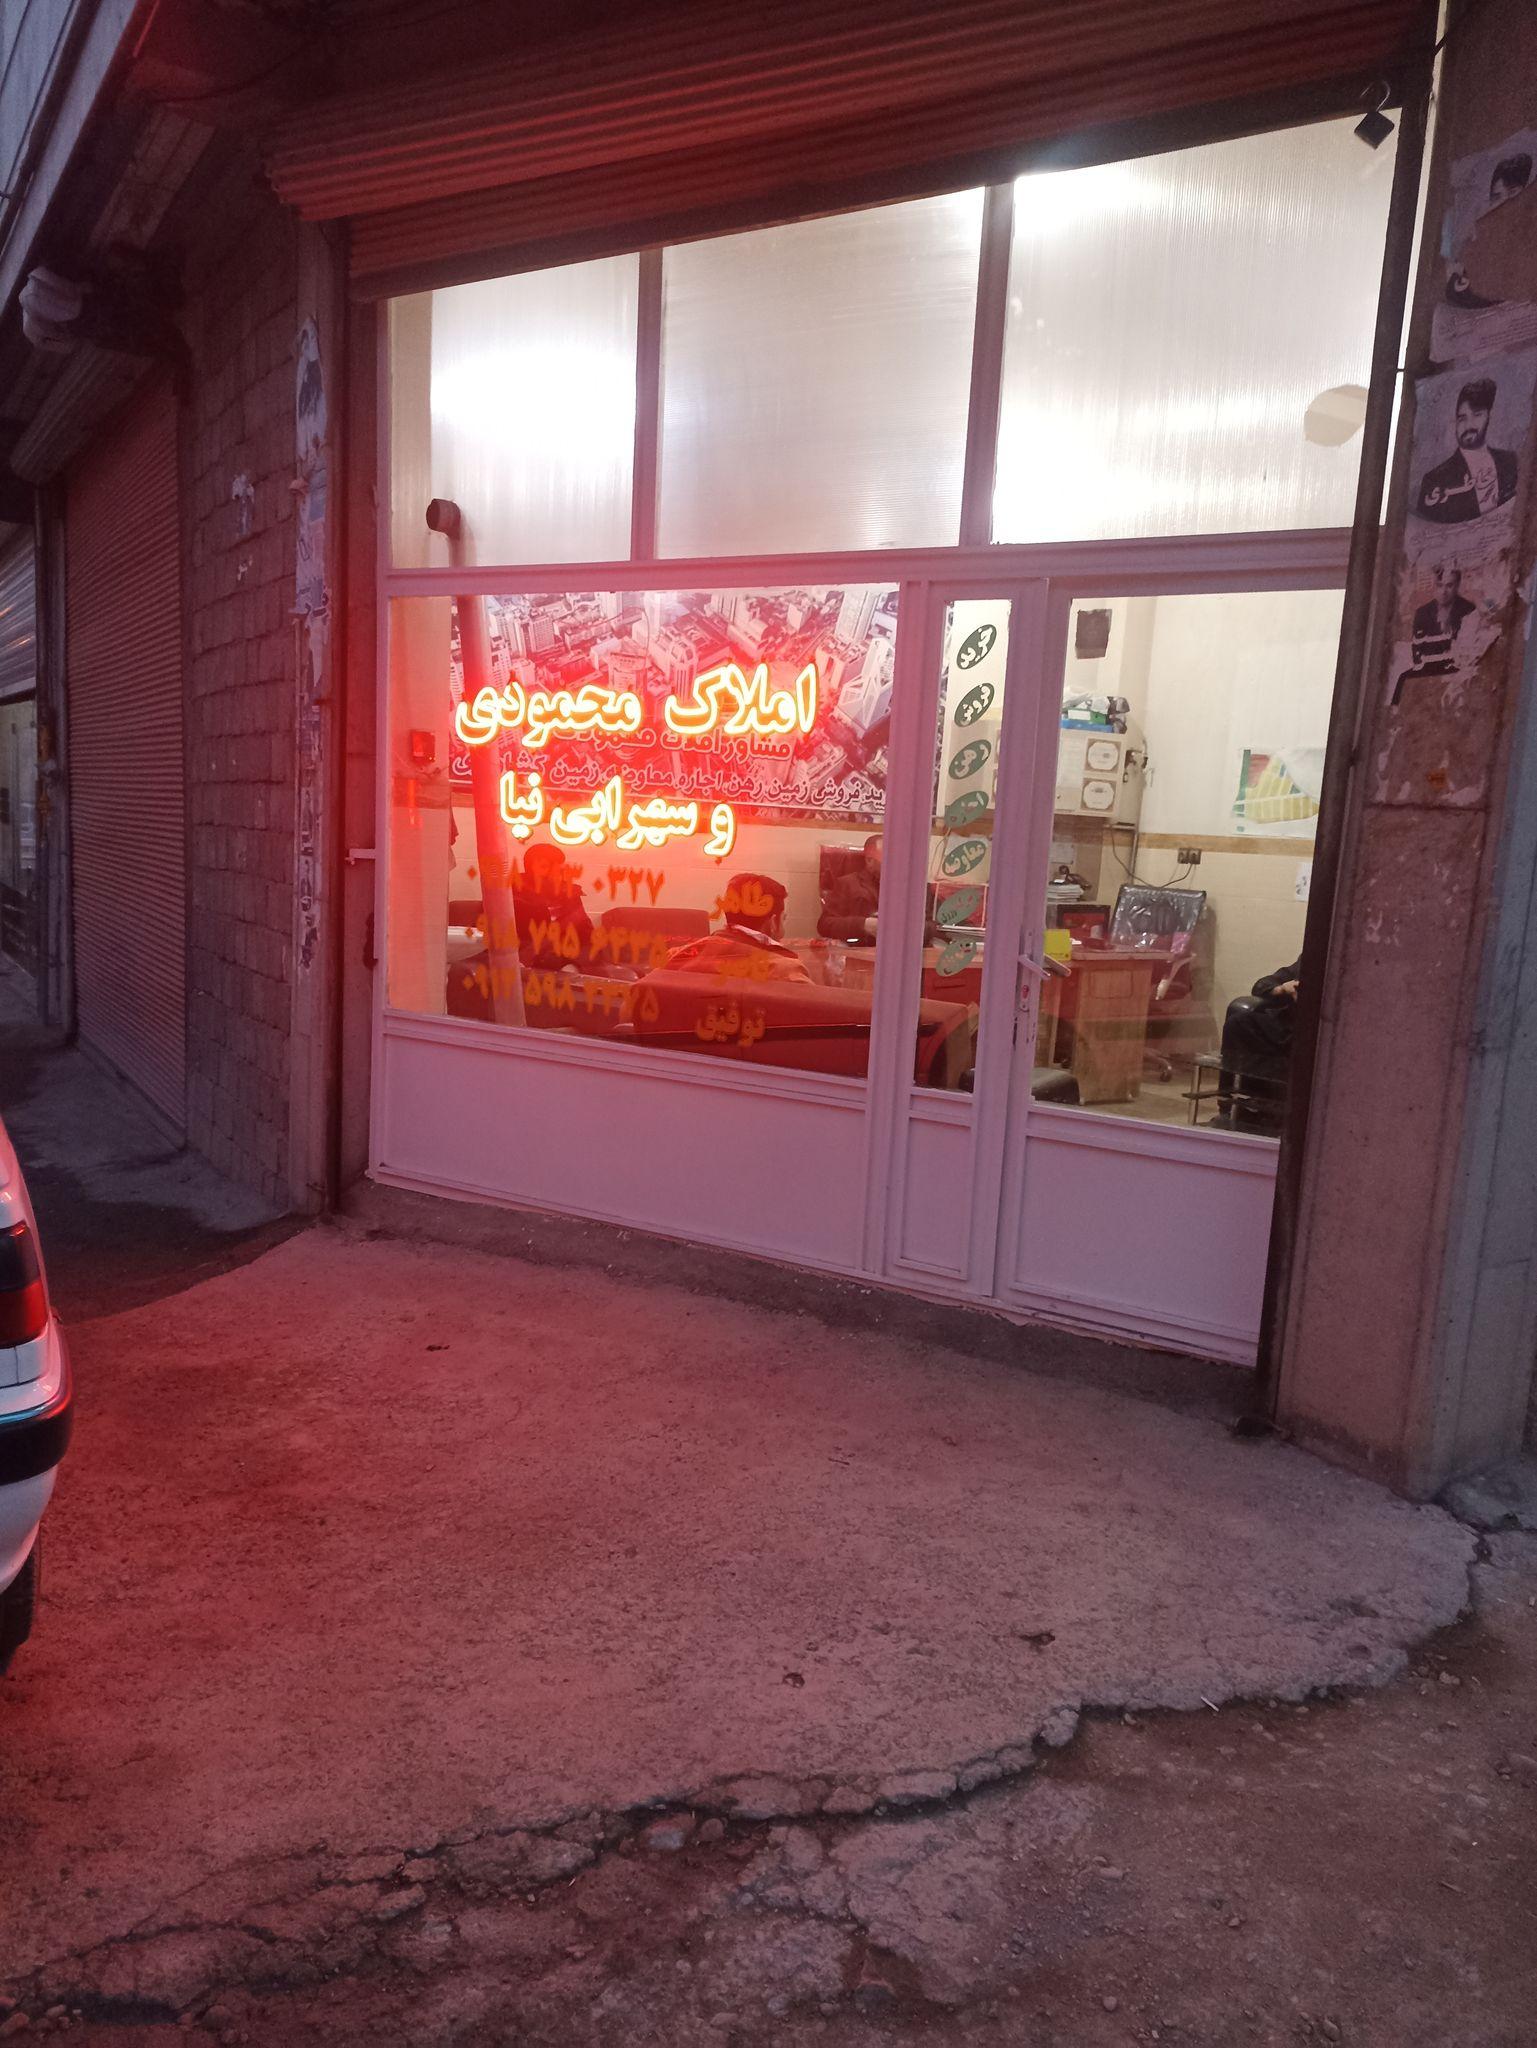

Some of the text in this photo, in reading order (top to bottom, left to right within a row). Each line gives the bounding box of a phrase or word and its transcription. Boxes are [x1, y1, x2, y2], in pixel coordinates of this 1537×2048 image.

[960, 626, 993, 669] خرید
[455, 662, 817, 748] املاک محمودی
[960, 683, 991, 726] فروش
[722, 732, 791, 764] مشاور
[953, 743, 989, 778] رهن
[549, 758, 600, 787] زمین
[810, 777, 860, 807] فروش
[500, 770, 736, 858] و سهرابی نیا
[944, 843, 985, 874] معاوضه
[593, 863, 666, 907] ۰۳۲۷
[708, 880, 775, 920] طاهر
[528, 917, 580, 960] ۷۹۵
[524, 969, 576, 1012] ۵۹۸
[695, 1001, 767, 1047] توفیق
